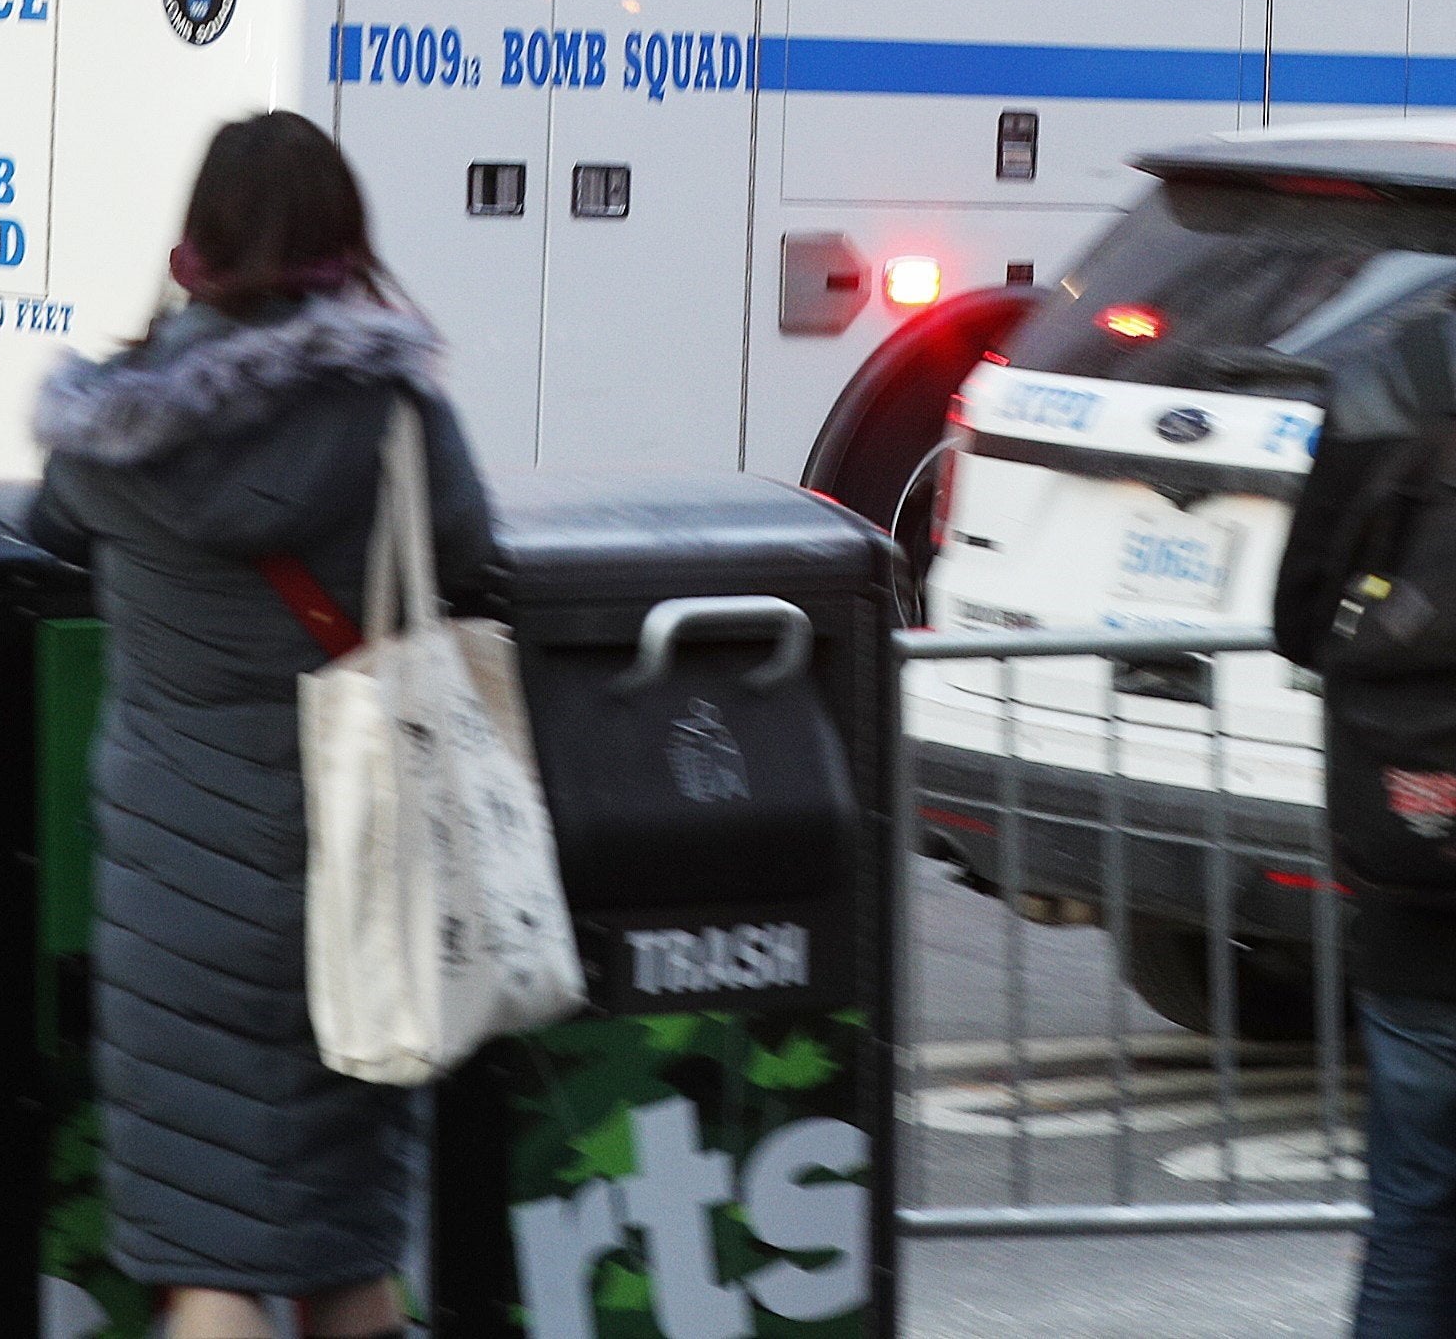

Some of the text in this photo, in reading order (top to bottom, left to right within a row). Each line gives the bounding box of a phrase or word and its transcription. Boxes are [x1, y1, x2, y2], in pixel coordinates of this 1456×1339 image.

[501, 29, 607, 89] BOMB
[623, 31, 743, 102] SQUAD
[15, 300, 74, 334] FEET
[623, 923, 811, 995] TRASH
